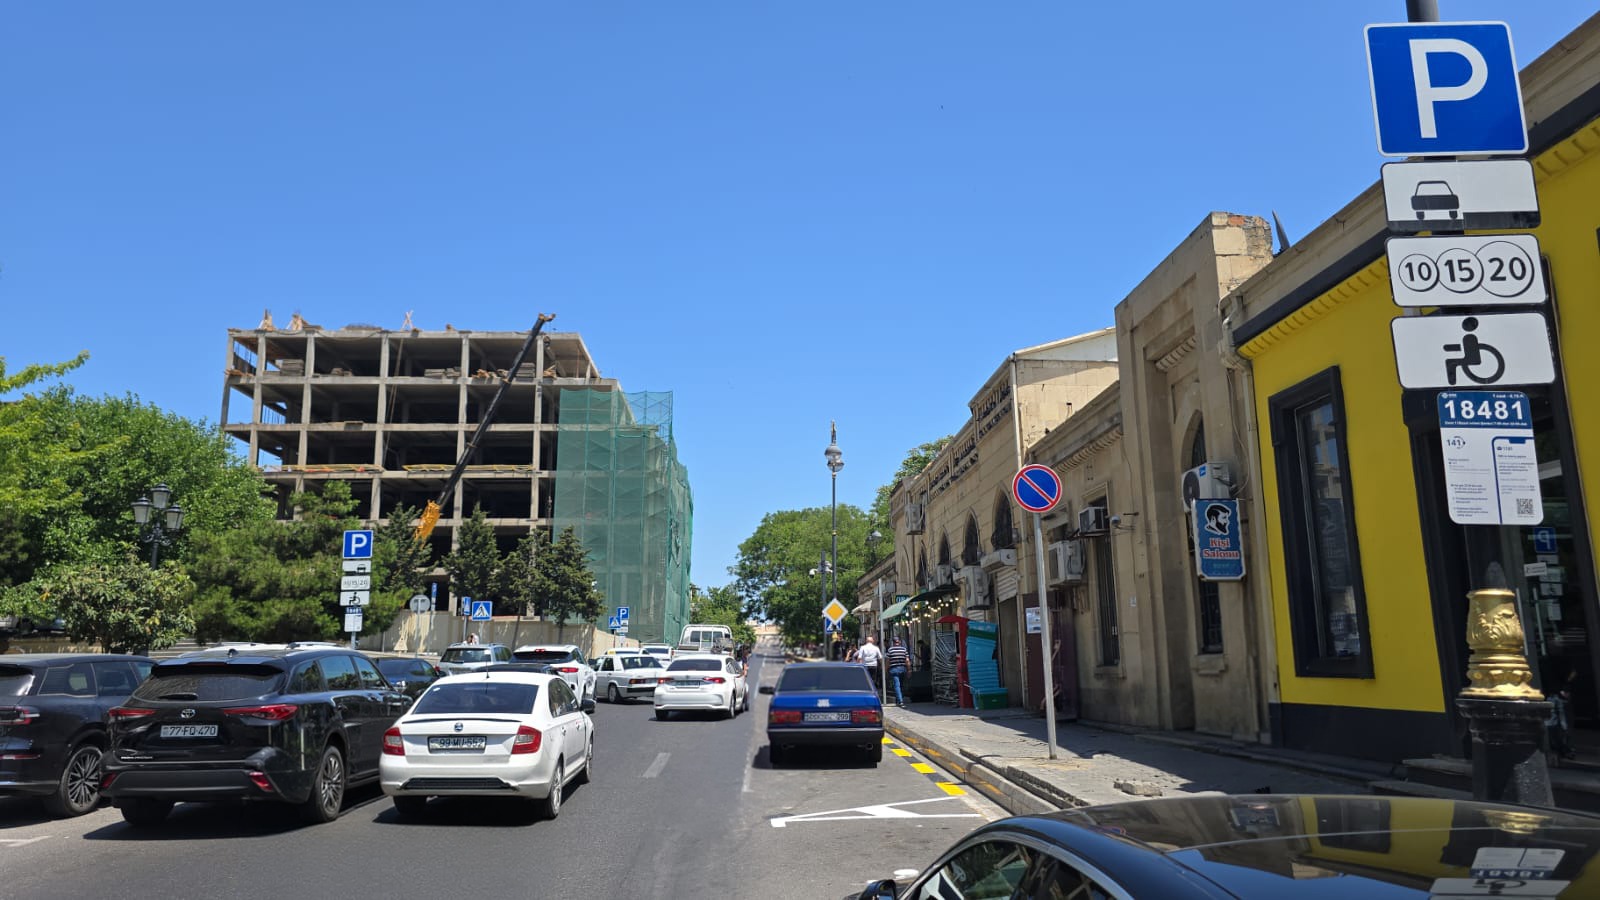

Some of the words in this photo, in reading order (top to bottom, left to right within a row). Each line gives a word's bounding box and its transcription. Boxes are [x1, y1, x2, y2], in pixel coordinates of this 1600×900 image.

[1409, 38, 1488, 139] P
[1405, 262, 1432, 282] 10
[1444, 259, 1475, 283] 15
[1488, 257, 1527, 281] 20
[1444, 400, 1524, 420] 18481
[351, 534, 367, 555] P
[1203, 549, 1240, 559] Salonu
[620, 609, 627, 618] P
